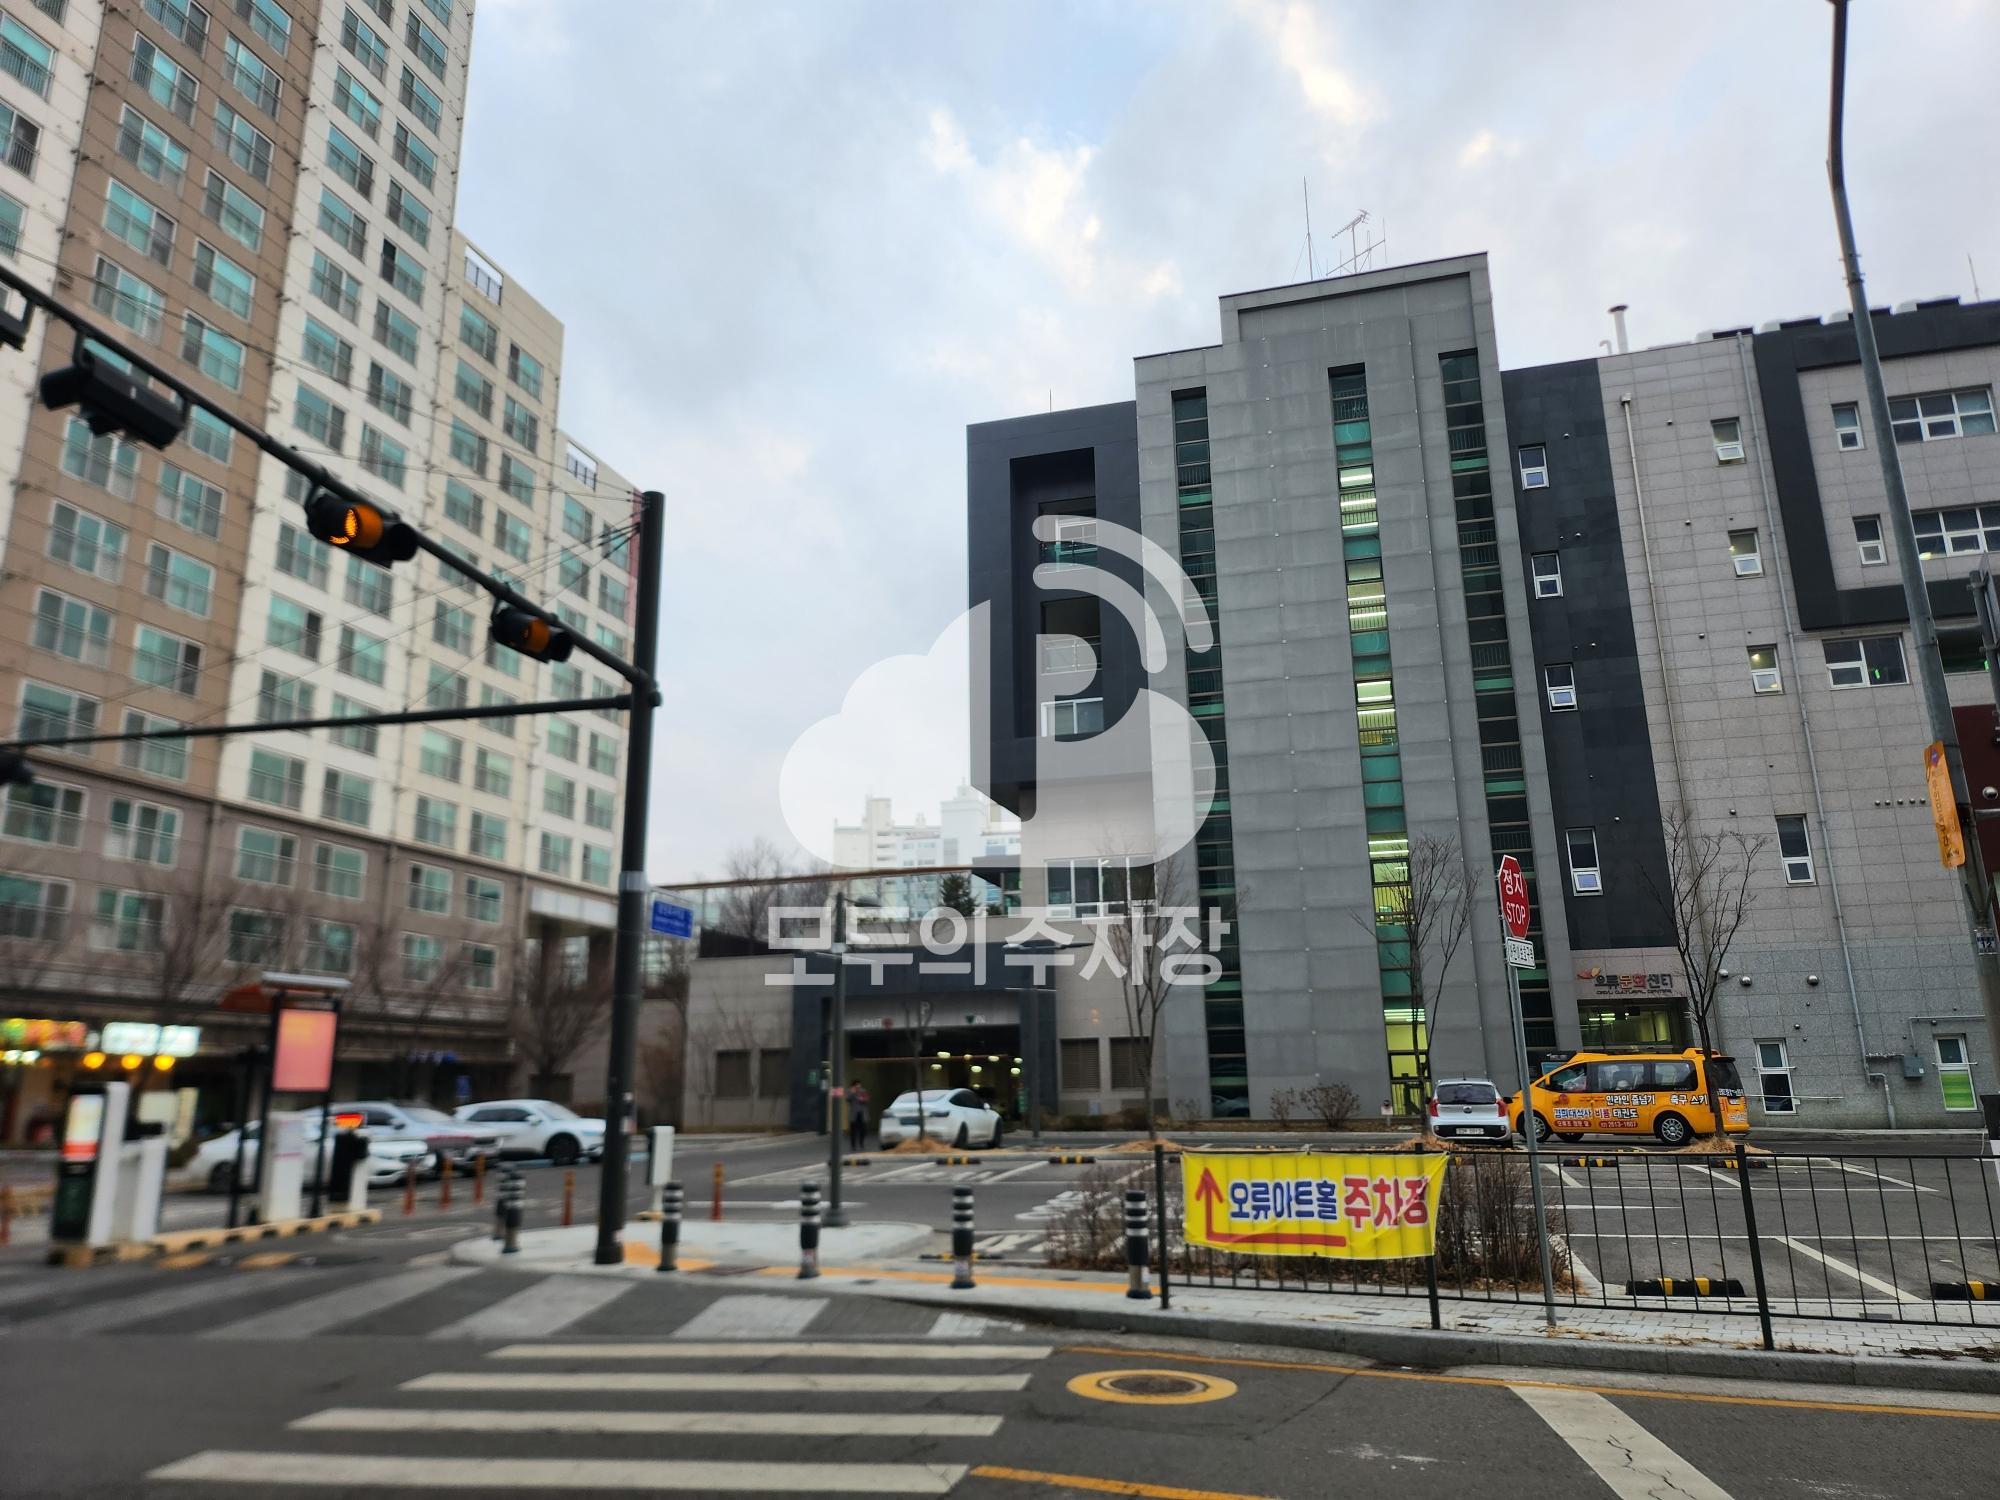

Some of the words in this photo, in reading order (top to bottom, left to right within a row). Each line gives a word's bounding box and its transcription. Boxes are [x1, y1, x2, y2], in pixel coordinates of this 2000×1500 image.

[1503, 869, 1524, 898] 정지
[1506, 901, 1526, 925] STOP
[1595, 974, 1673, 990] 오류문화센터
[1612, 1108, 1638, 1119] 태권도
[1230, 1180, 1338, 1221] 오류아트홀
[1343, 1176, 1429, 1229] 주차장
